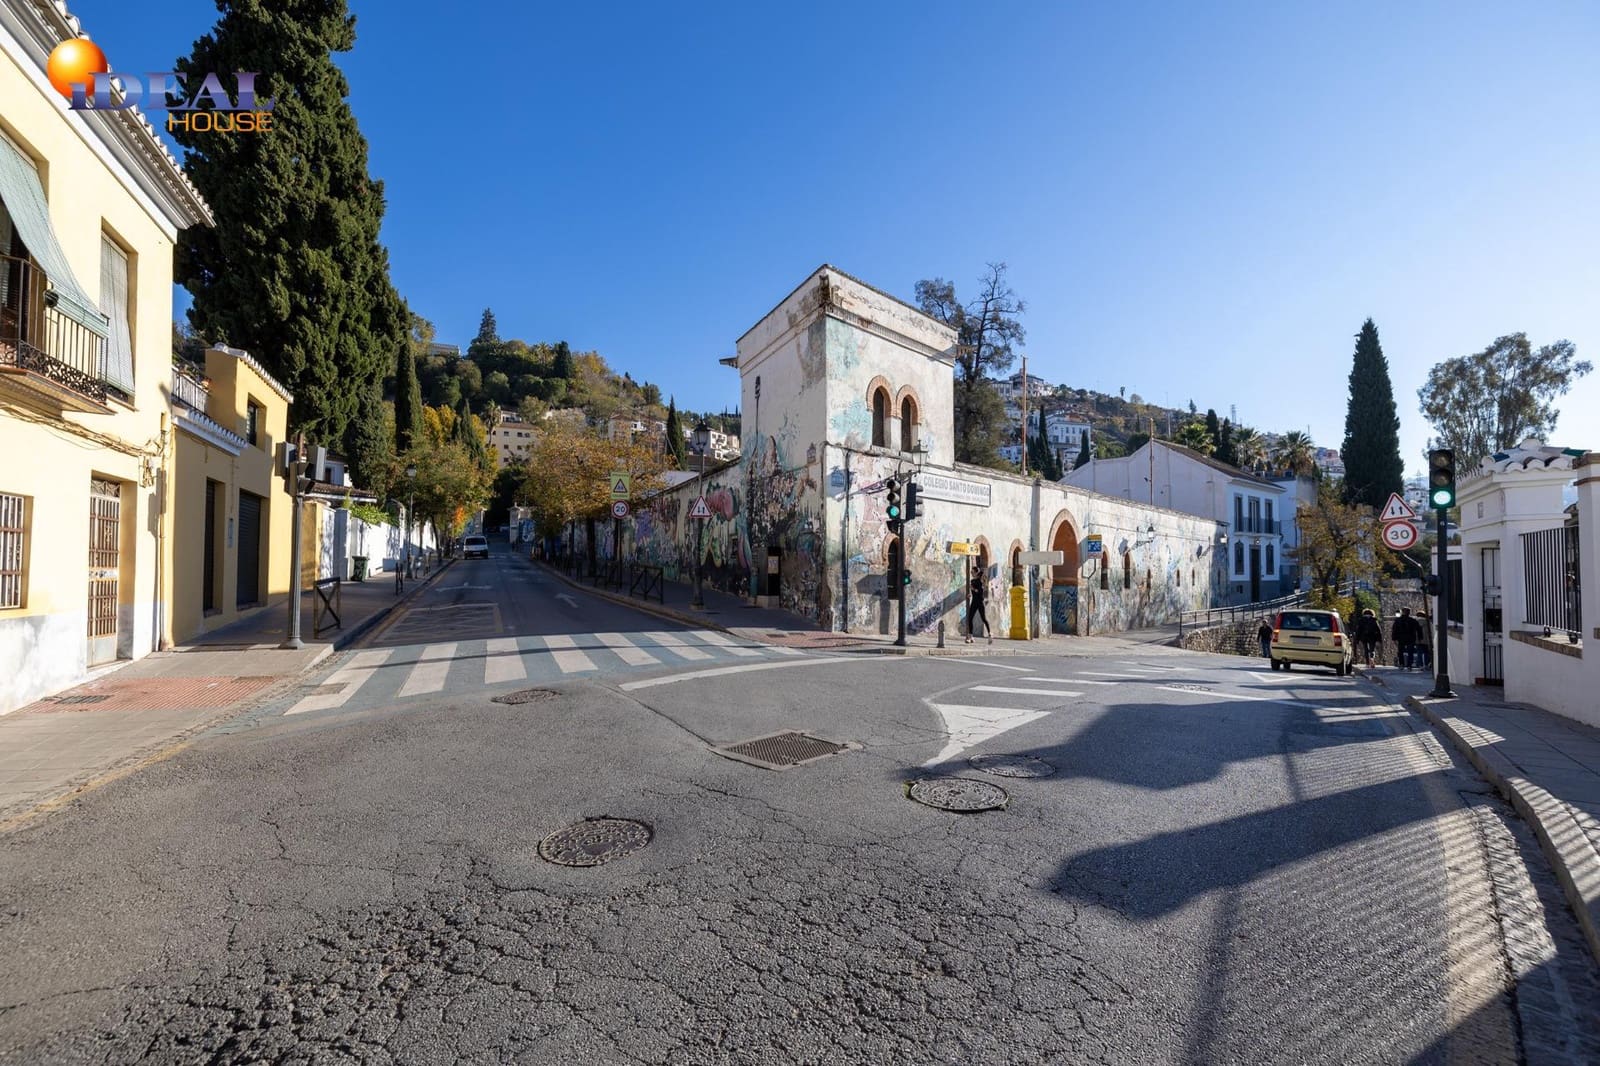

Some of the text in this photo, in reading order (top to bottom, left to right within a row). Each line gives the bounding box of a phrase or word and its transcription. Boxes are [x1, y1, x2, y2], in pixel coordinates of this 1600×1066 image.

[924, 476, 948, 490] COLEGIO
[949, 480, 966, 493] SANTO
[967, 484, 989, 497] DOMINGO
[616, 505, 626, 513] 20
[1391, 529, 1410, 540] 30
